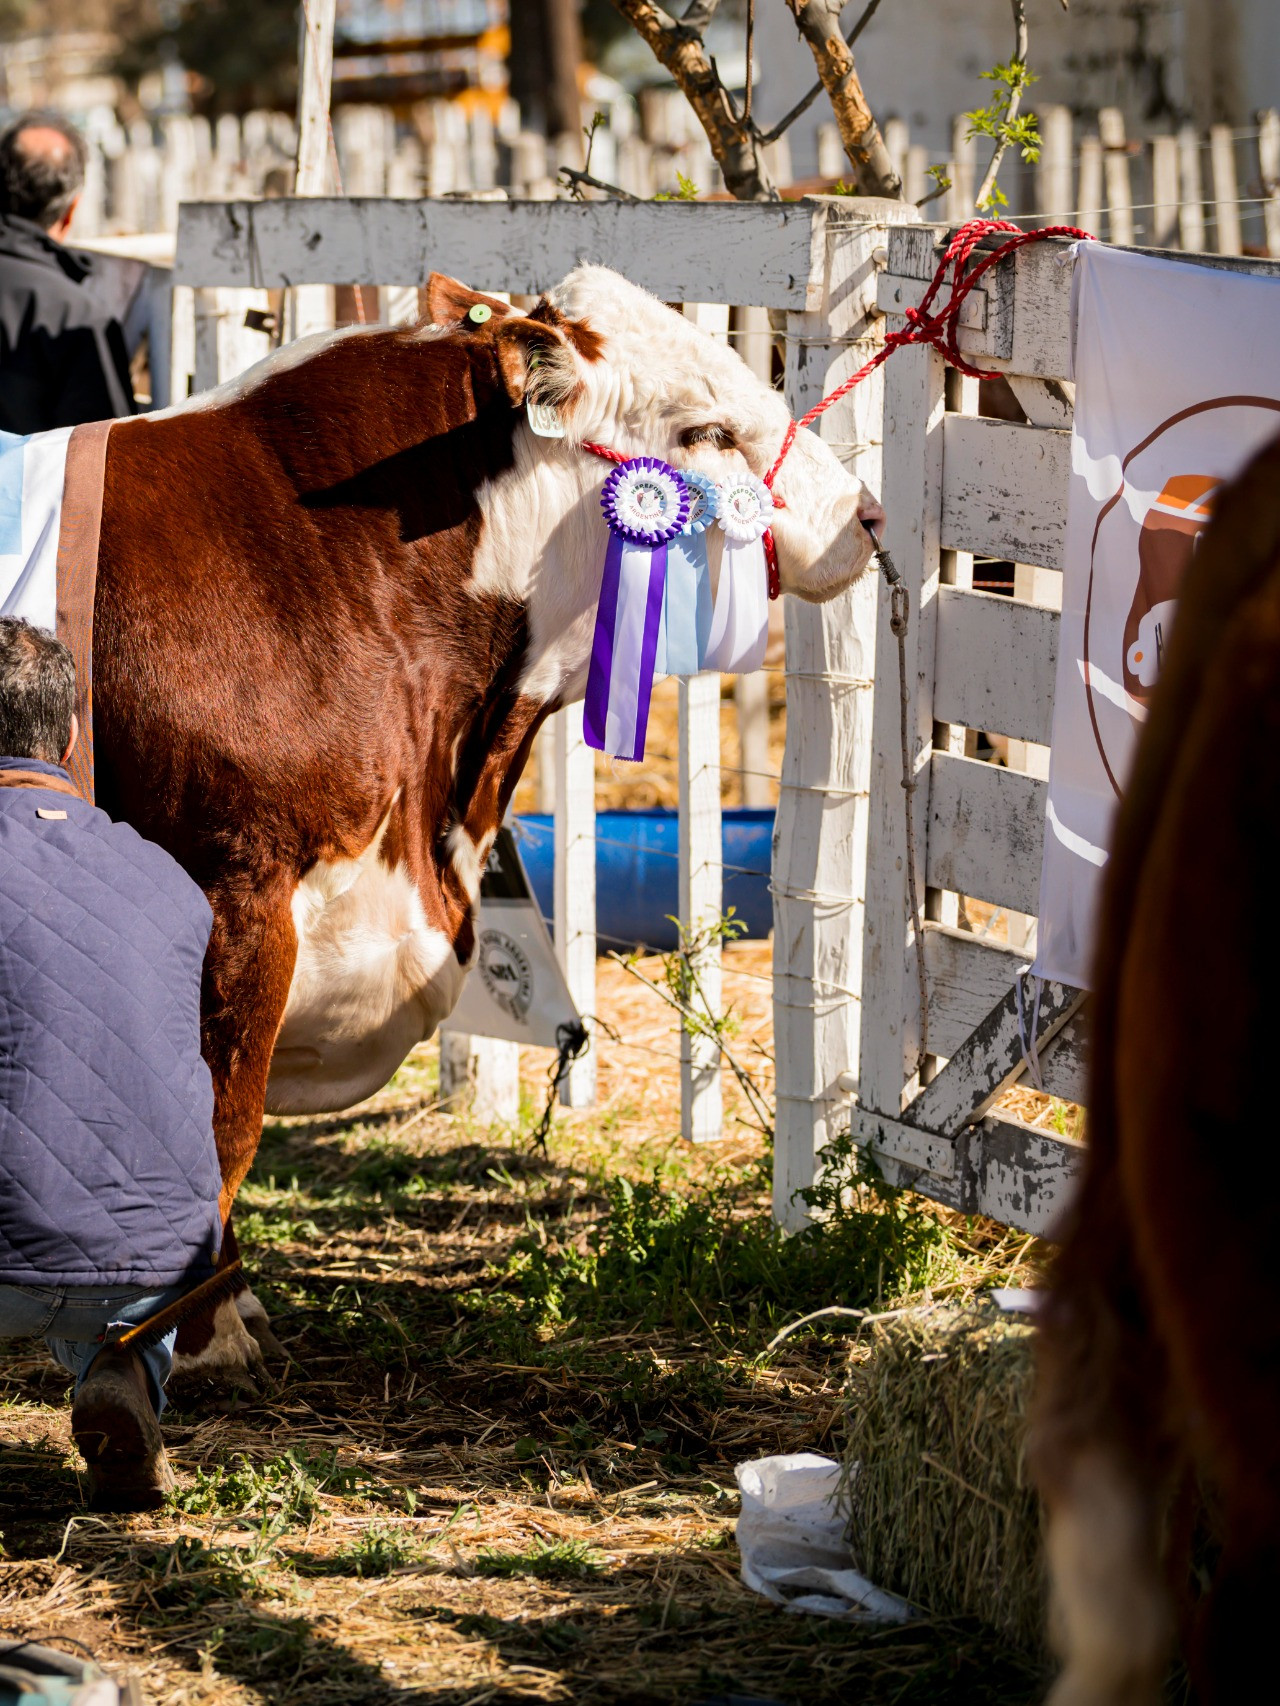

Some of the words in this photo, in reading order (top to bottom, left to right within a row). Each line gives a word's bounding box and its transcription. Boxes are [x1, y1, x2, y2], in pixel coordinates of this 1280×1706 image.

[631, 483, 664, 501] HEREFORD
[727, 488, 757, 504] HEREFORD
[629, 505, 664, 520] ARGENTINA
[730, 510, 759, 525] ARGENTINA
